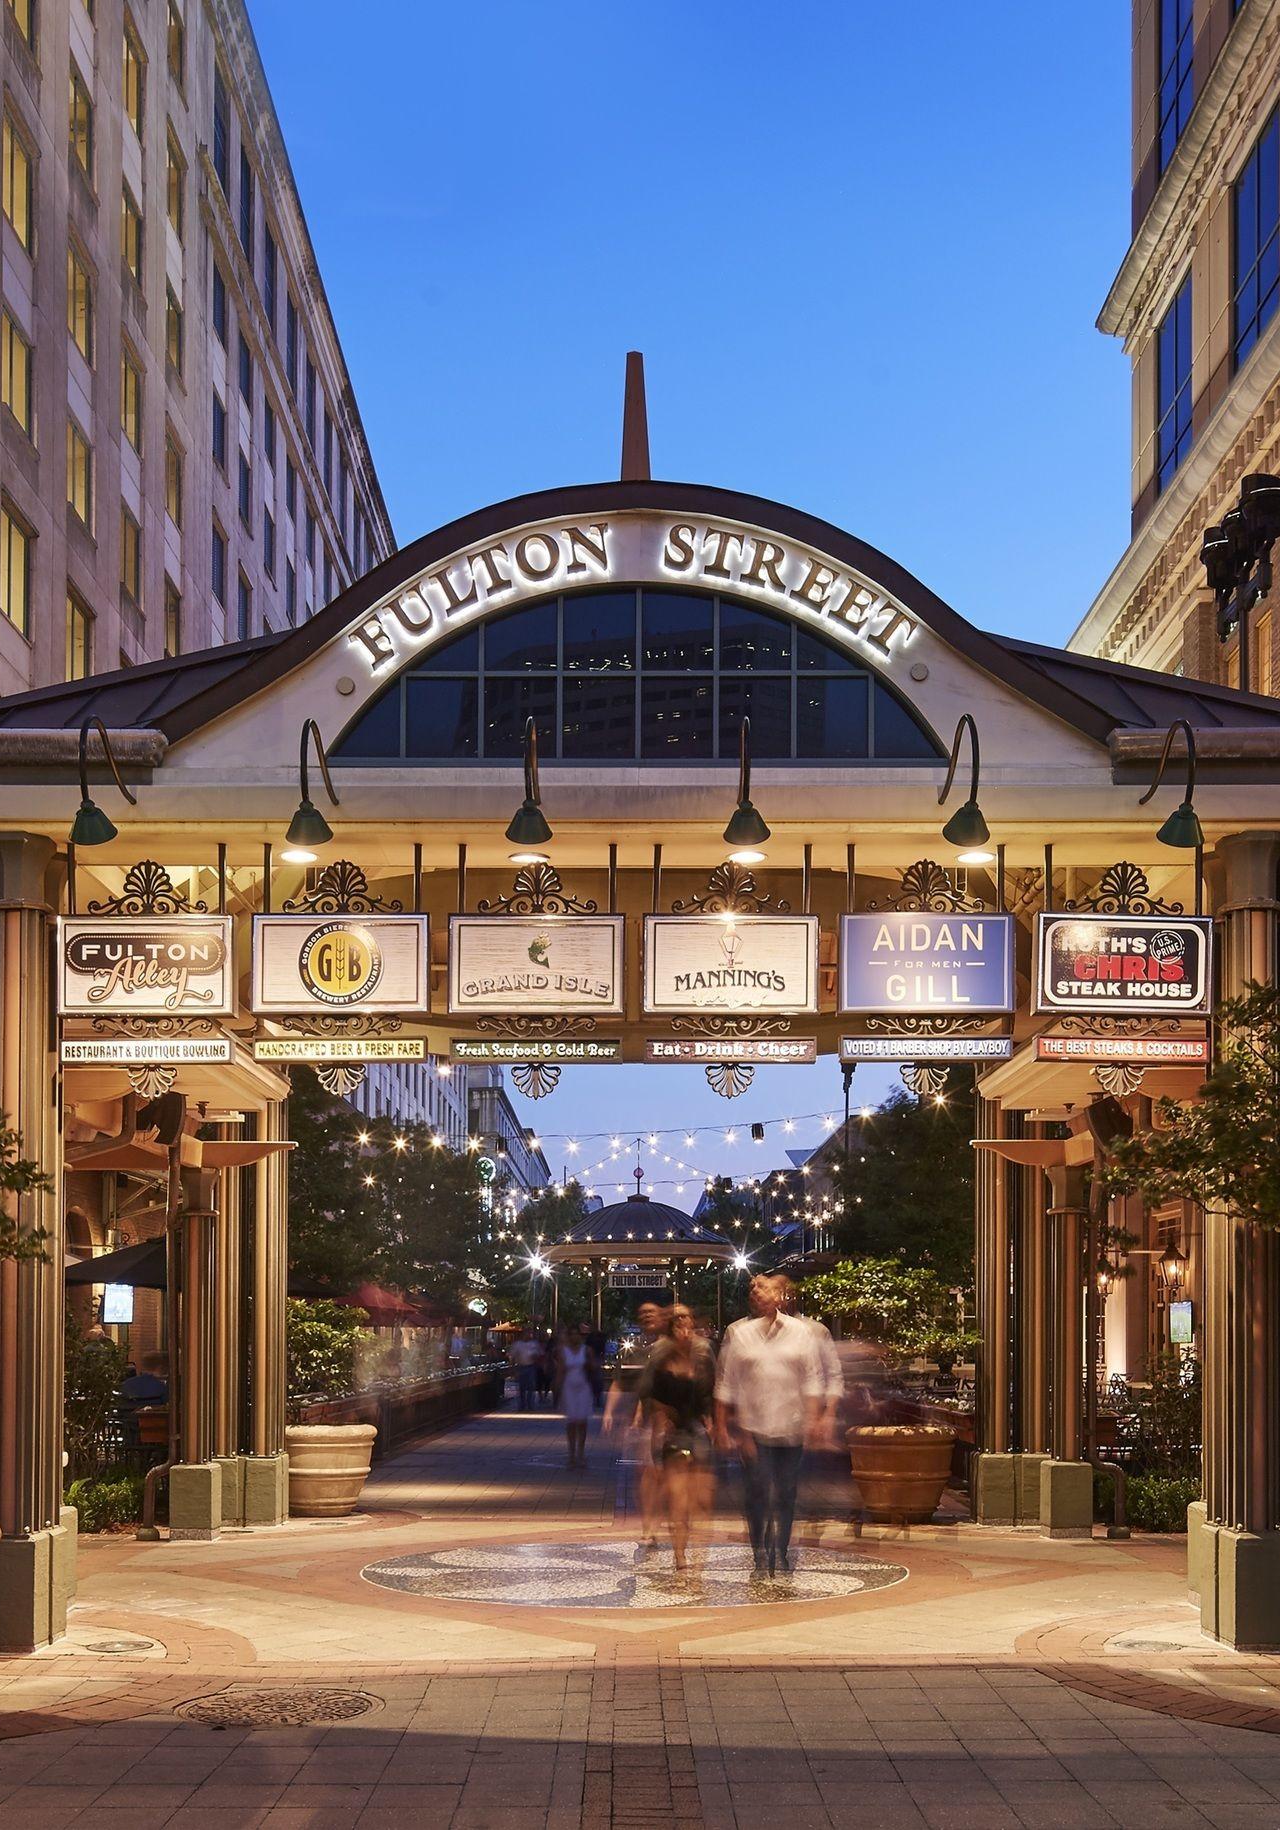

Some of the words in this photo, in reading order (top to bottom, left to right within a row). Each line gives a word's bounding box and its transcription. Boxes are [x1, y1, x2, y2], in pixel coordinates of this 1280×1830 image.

[349, 523, 609, 672] FULTON
[663, 523, 917, 658] STREET
[872, 923, 984, 951] AIDAN
[1157, 936, 1173, 947] U.S.
[81, 944, 209, 961] FULTON
[301, 933, 321, 965] GORDON
[1156, 942, 1181, 959] PRIME
[893, 960, 924, 968] FOR
[931, 960, 962, 968] MEN
[1074, 954, 1184, 981] CHRIS
[87, 957, 213, 1010] Alley
[311, 986, 350, 1003] BREWERY
[350, 953, 380, 1000] RESTAURANT
[462, 973, 548, 998] GRAND
[554, 974, 610, 999] ISLE
[674, 969, 786, 992] MANNING'S
[885, 974, 971, 1002] GILL
[1056, 981, 1121, 996] STEAK
[1127, 982, 1192, 997] HOUSE
[64, 1045, 123, 1058] RESTAURANT
[125, 1046, 132, 1058] &
[134, 1045, 180, 1058] BOUTIQUE
[182, 1045, 226, 1057] BOWLING
[258, 1043, 327, 1056] HANDCRAFTED
[330, 1043, 354, 1056] BEER
[356, 1043, 362, 1056] &
[364, 1043, 394, 1056] FRESH
[397, 1043, 421, 1056] FARE
[455, 1043, 489, 1056] Fresh
[491, 1043, 540, 1058] Seafood
[541, 1043, 553, 1057] &
[555, 1043, 585, 1057] Cold
[586, 1043, 616, 1057] Beer
[652, 1042, 681, 1057] Eat
[694, 1042, 745, 1057] Drink
[757, 1042, 808, 1057] Cheer
[846, 1040, 876, 1055] VOTED
[890, 1040, 927, 1055] BARBER
[928, 1040, 951, 1055] SHOP
[953, 1040, 968, 1055] BY
[968, 1040, 1007, 1056] PLAYBOY
[1043, 1040, 1063, 1054] THE
[1066, 1041, 1091, 1055] BEST
[1094, 1042, 1133, 1055] STEAKS
[1137, 1043, 1143, 1055] &
[1146, 1043, 1203, 1057] COCKTAILS
[612, 1275, 637, 1286] FULTON
[638, 1275, 664, 1286] STREET
